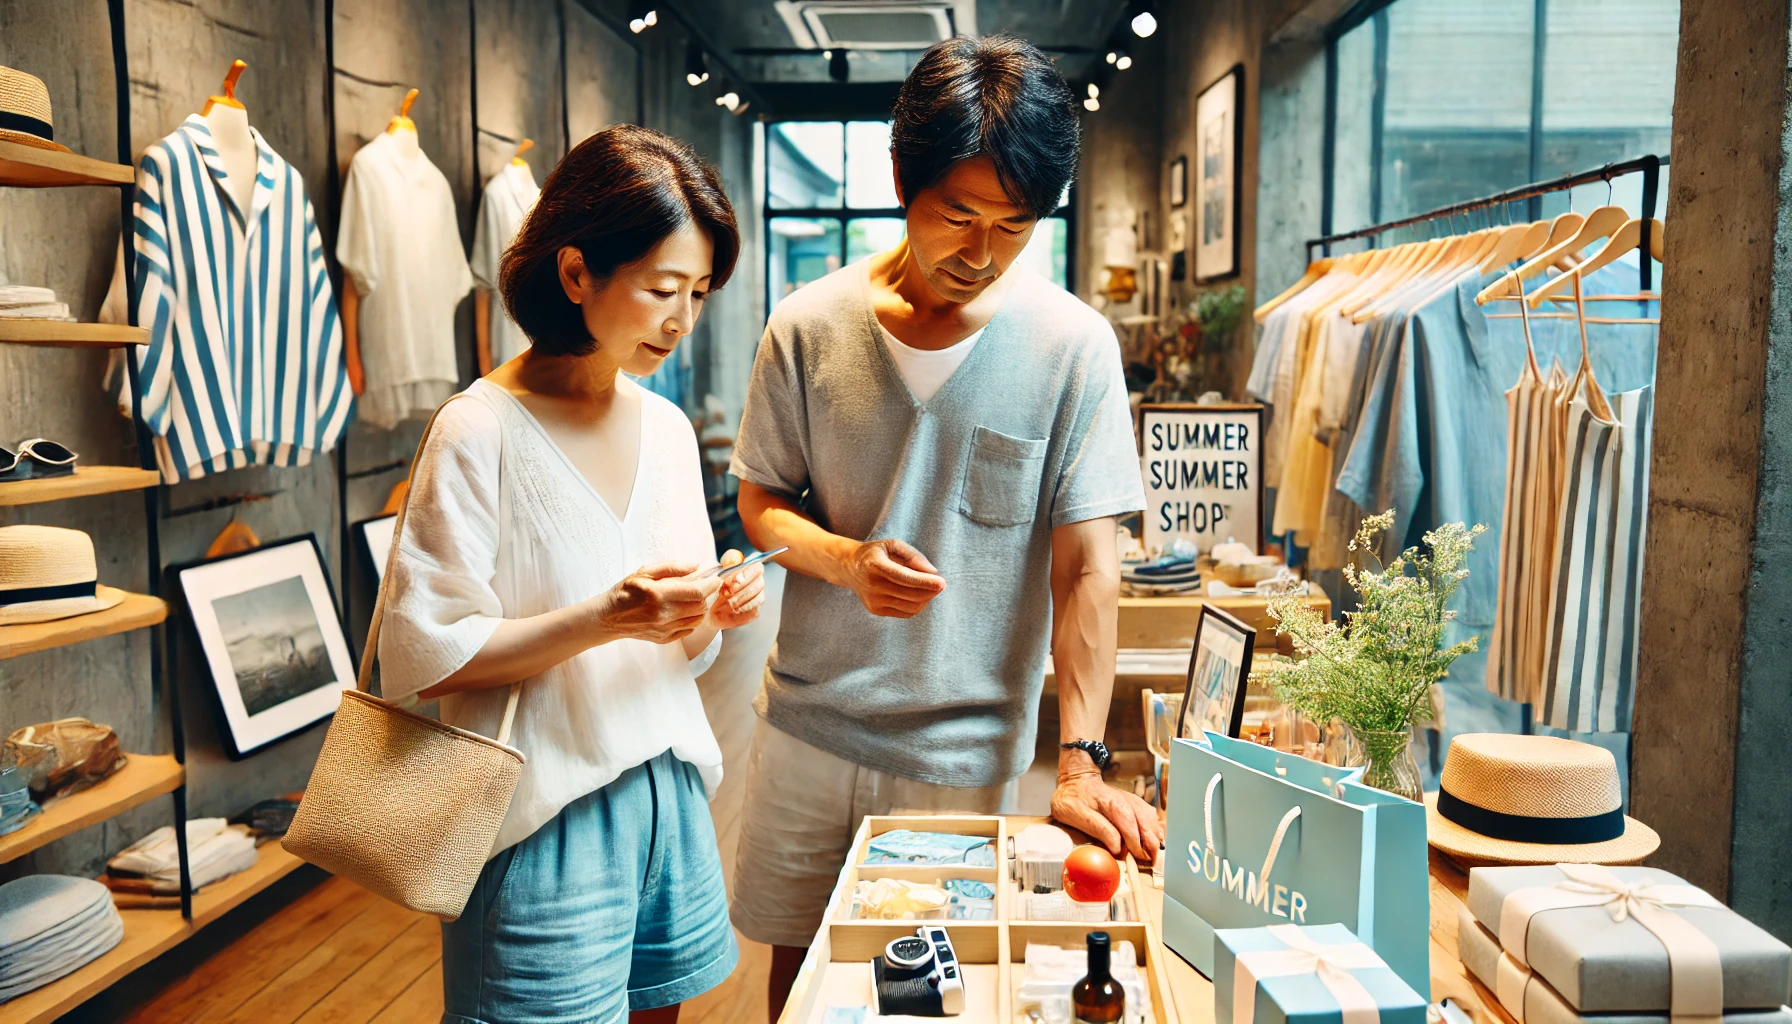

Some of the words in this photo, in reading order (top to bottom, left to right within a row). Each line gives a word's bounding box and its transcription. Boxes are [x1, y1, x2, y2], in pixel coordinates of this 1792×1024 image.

[1151, 423, 1249, 451] SUMMER
[1150, 459, 1248, 490] SUMMER
[1187, 840, 1308, 923] SUMMER
